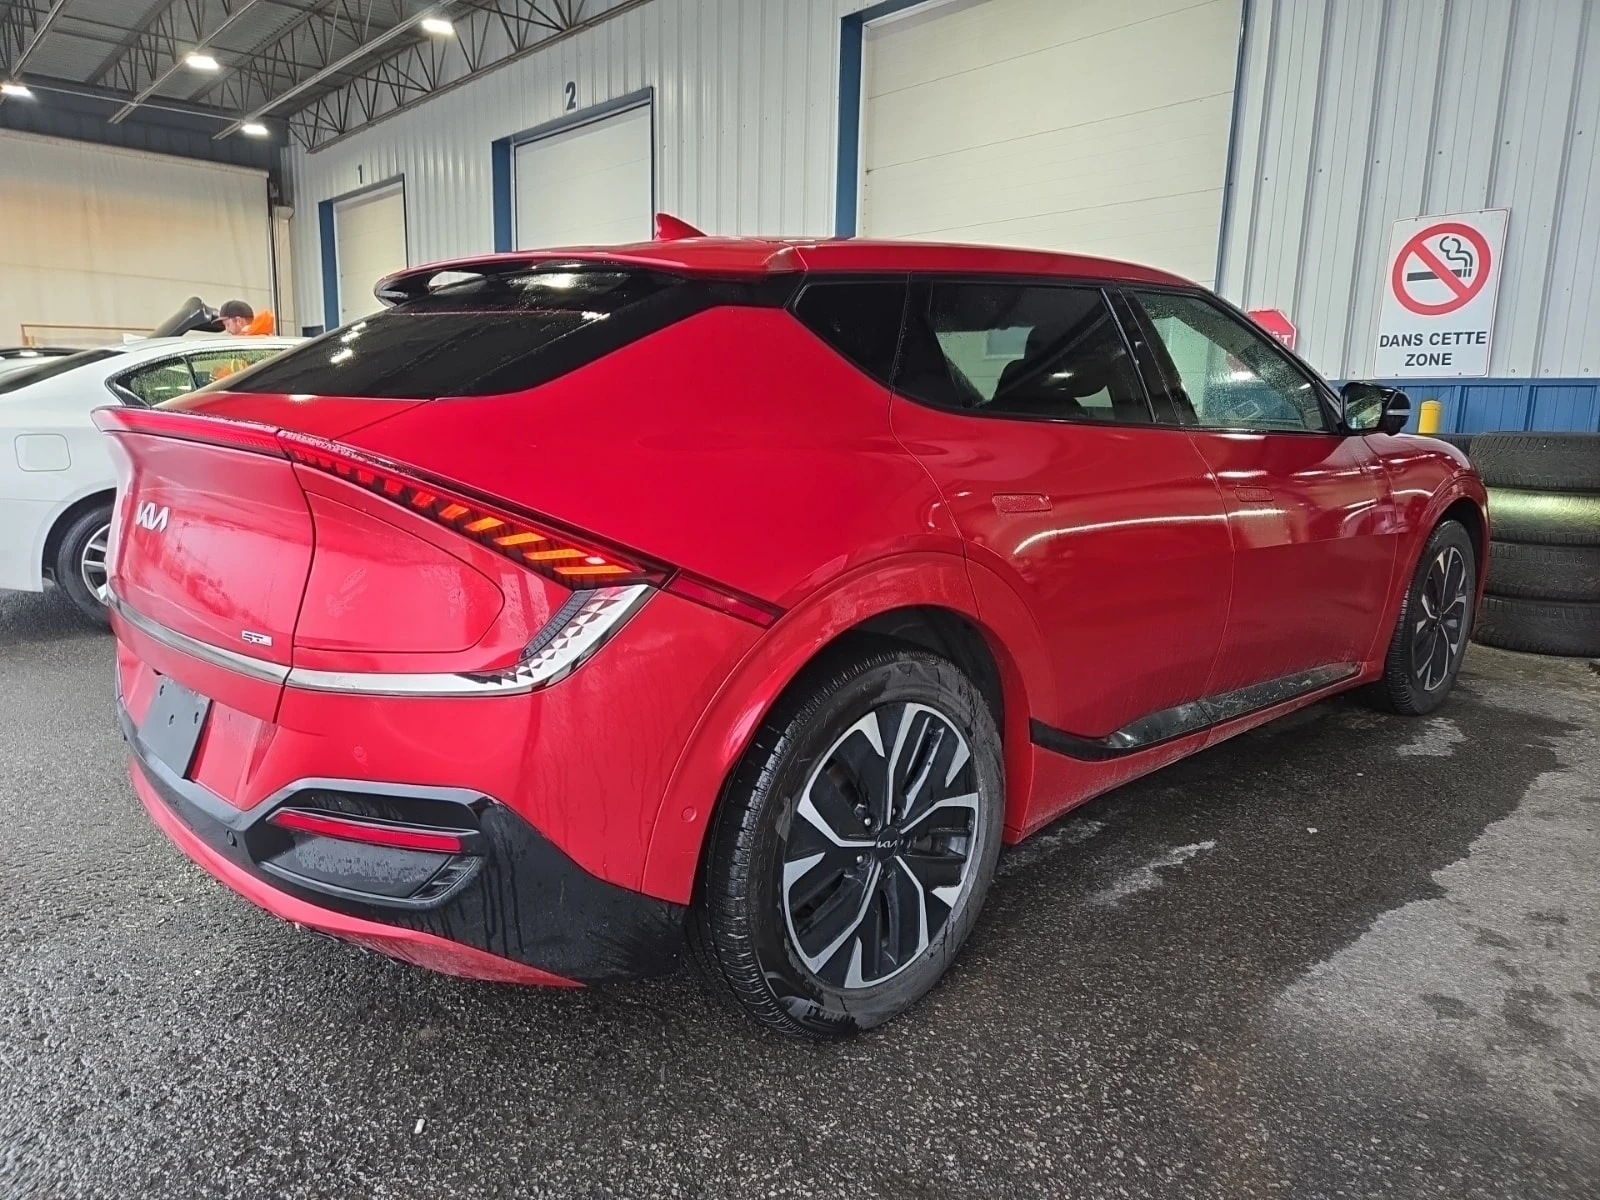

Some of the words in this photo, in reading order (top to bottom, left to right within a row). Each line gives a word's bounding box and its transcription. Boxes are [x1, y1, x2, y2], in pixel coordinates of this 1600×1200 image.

[566, 81, 576, 110] 2
[358, 164, 363, 184] 1
[1380, 333, 1423, 347] DANS
[1429, 331, 1487, 345] CETTE
[1405, 353, 1452, 366] ZONE
